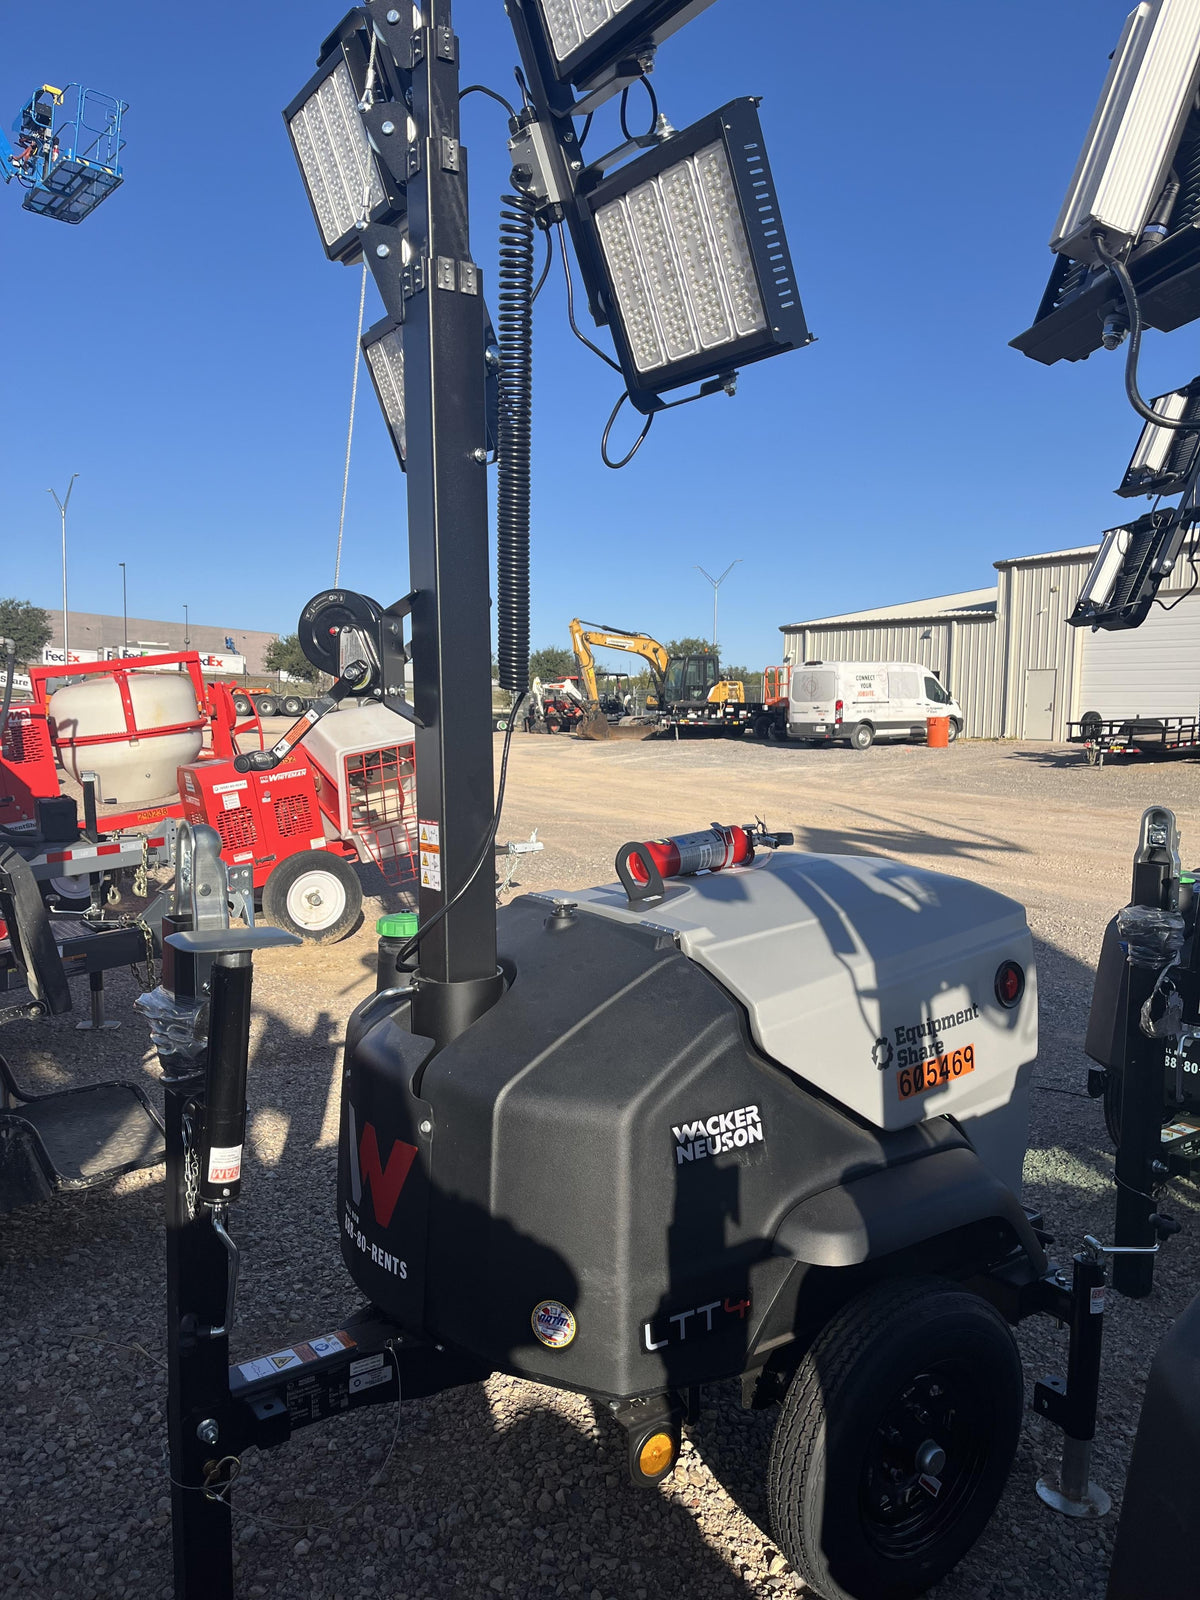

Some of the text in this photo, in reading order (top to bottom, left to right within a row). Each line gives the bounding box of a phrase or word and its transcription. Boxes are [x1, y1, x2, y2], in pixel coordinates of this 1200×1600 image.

[894, 1003, 979, 1046] Equipment
[897, 1040, 945, 1068] Share
[899, 1045, 975, 1097] 605469
[671, 1105, 761, 1144] WACKER
[676, 1122, 764, 1165] NEUSON
[344, 1212, 407, 1279] 888-80-RENTS
[644, 1297, 750, 1351] LTT4
